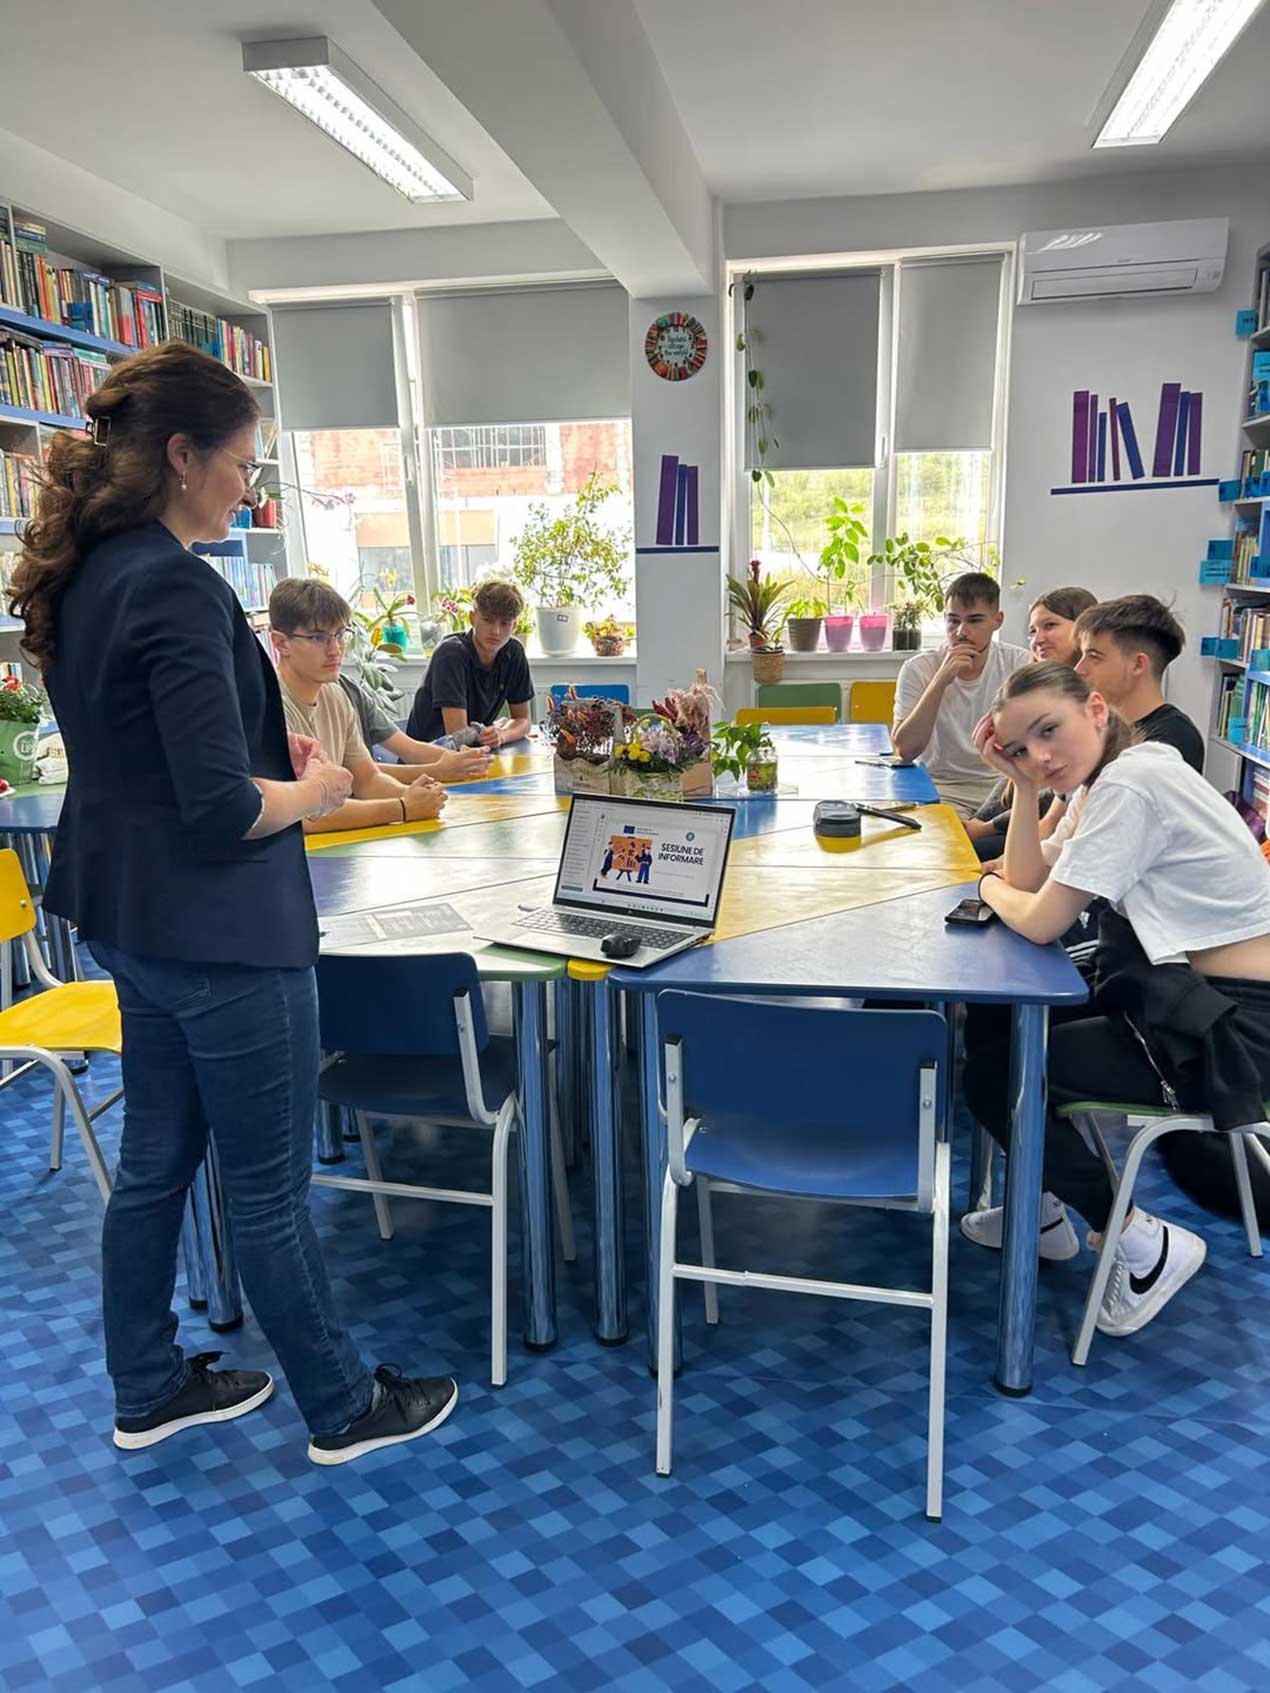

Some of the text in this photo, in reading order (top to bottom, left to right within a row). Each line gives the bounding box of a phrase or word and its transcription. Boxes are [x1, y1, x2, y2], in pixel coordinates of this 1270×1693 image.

[661, 843, 704, 856] SESIUNE DE
[658, 853, 704, 866] INFORMARE
